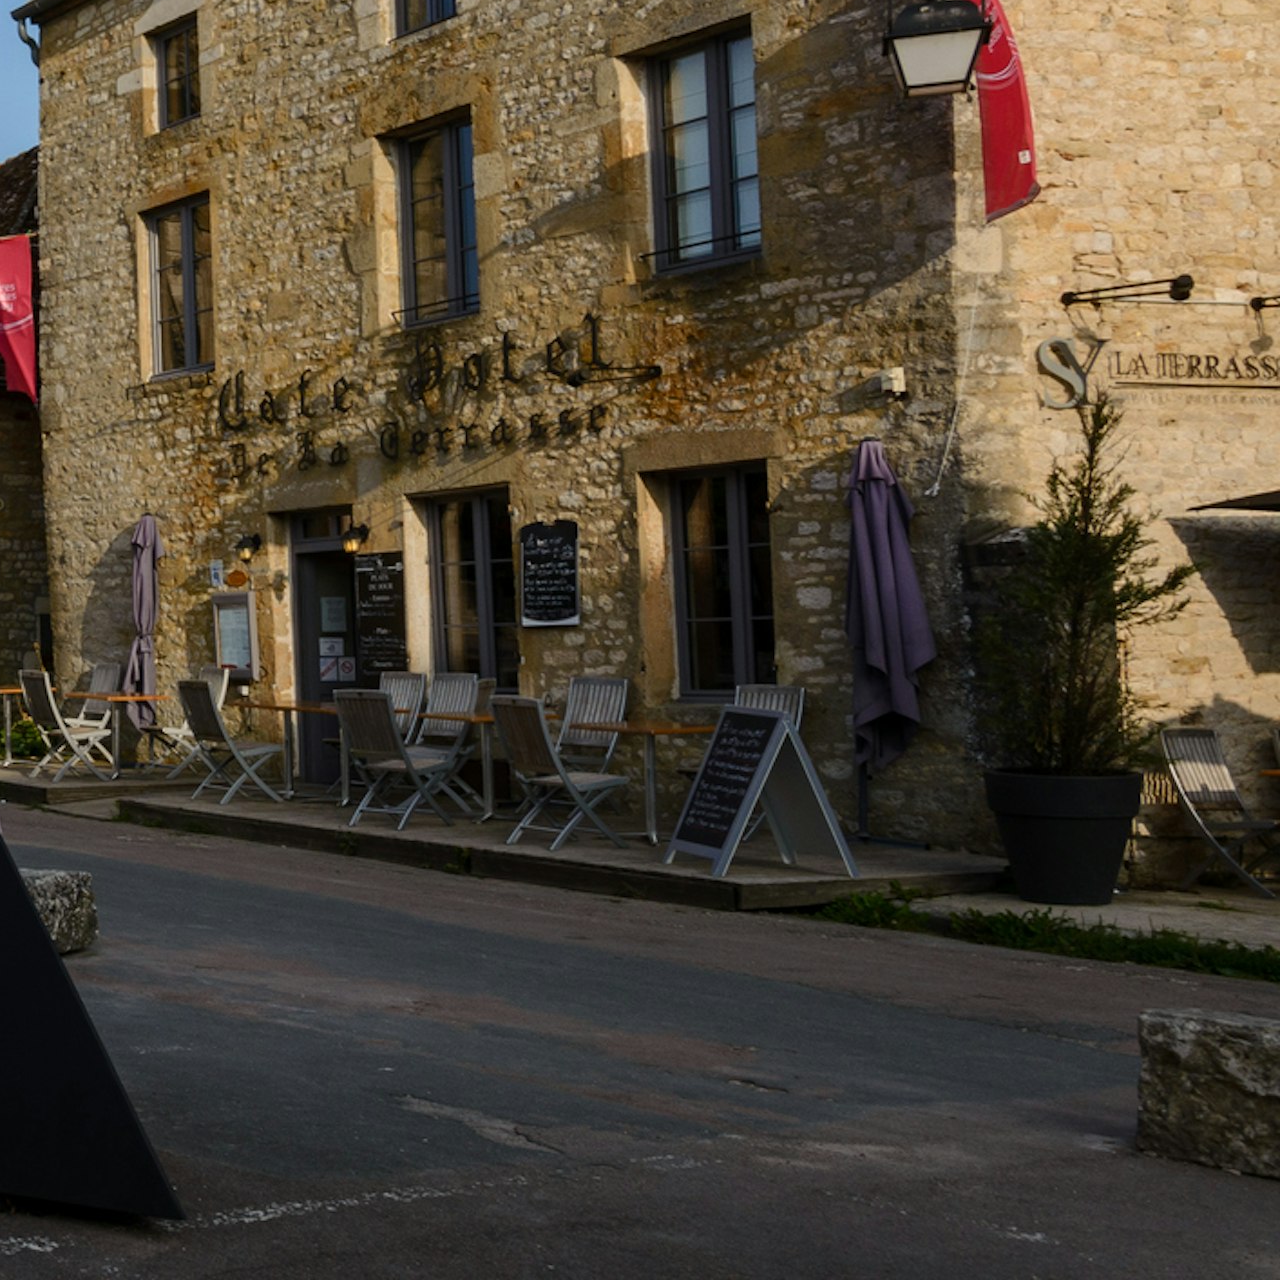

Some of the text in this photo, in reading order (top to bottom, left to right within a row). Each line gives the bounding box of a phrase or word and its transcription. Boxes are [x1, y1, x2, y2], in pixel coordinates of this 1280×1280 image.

[406, 314, 613, 402] Hotel
[1157, 352, 1280, 380] TERRASS
[380, 404, 608, 461] Terrasse
